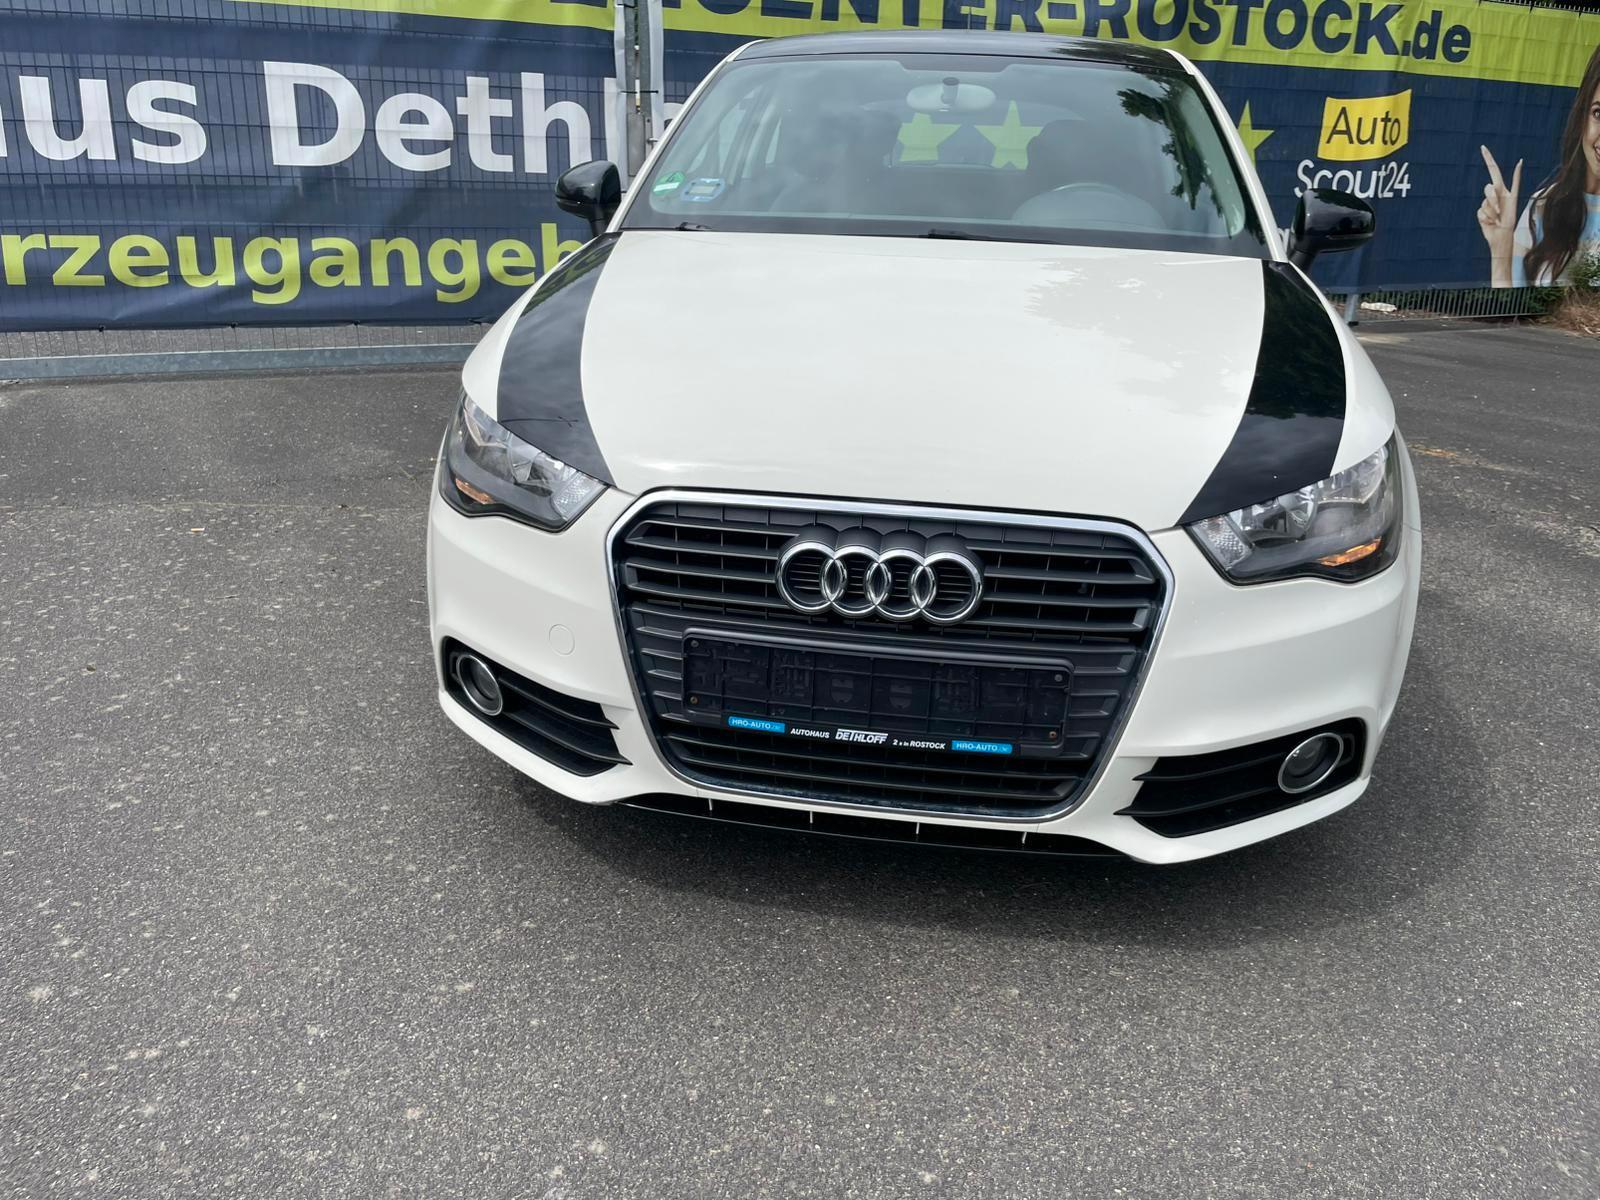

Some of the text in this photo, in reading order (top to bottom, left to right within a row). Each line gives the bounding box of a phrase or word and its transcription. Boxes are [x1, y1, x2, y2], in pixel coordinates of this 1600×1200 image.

[0, 75, 207, 164] us
[1325, 106, 1401, 146] Auto
[1294, 159, 1411, 199] Scout24
[790, 728, 830, 739] AUTOHAUS
[909, 740, 946, 750] ROSTOCK
